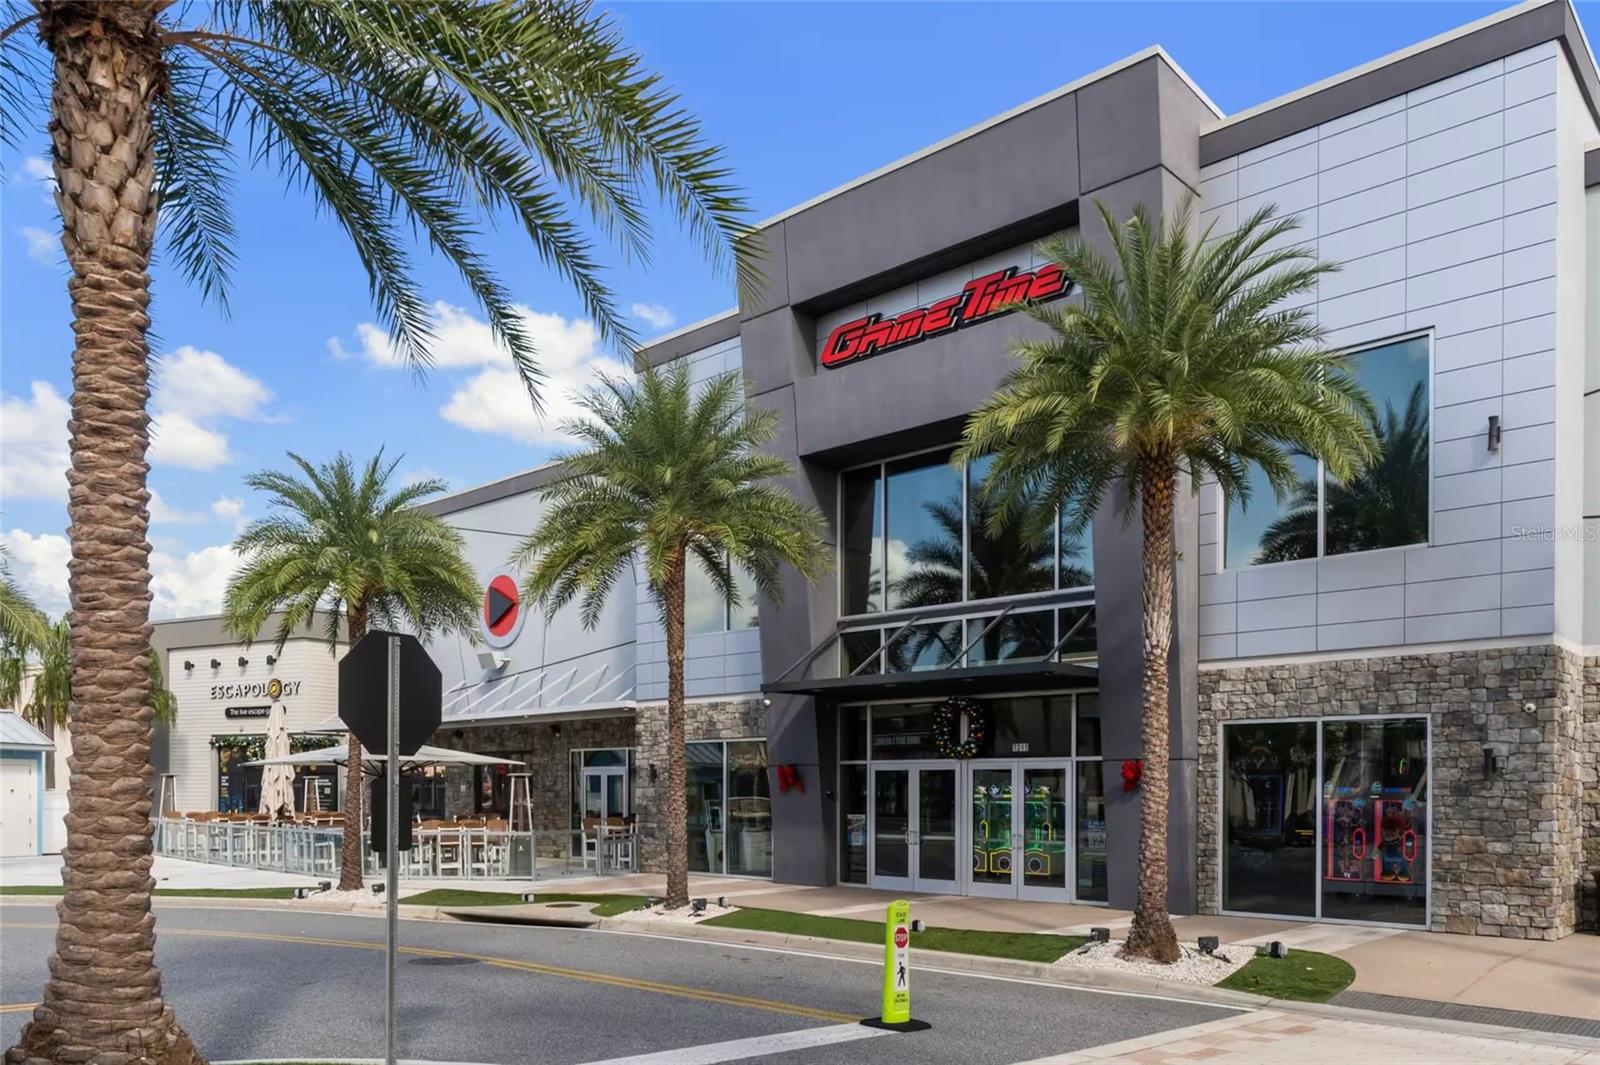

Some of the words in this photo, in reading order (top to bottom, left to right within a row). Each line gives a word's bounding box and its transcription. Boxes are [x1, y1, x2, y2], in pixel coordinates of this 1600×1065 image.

[210, 680, 302, 700] ESCAPOLOGY
[229, 708, 239, 716] The
[239, 708, 248, 716] live
[248, 708, 265, 716] escape
[895, 933, 908, 942] STOP
